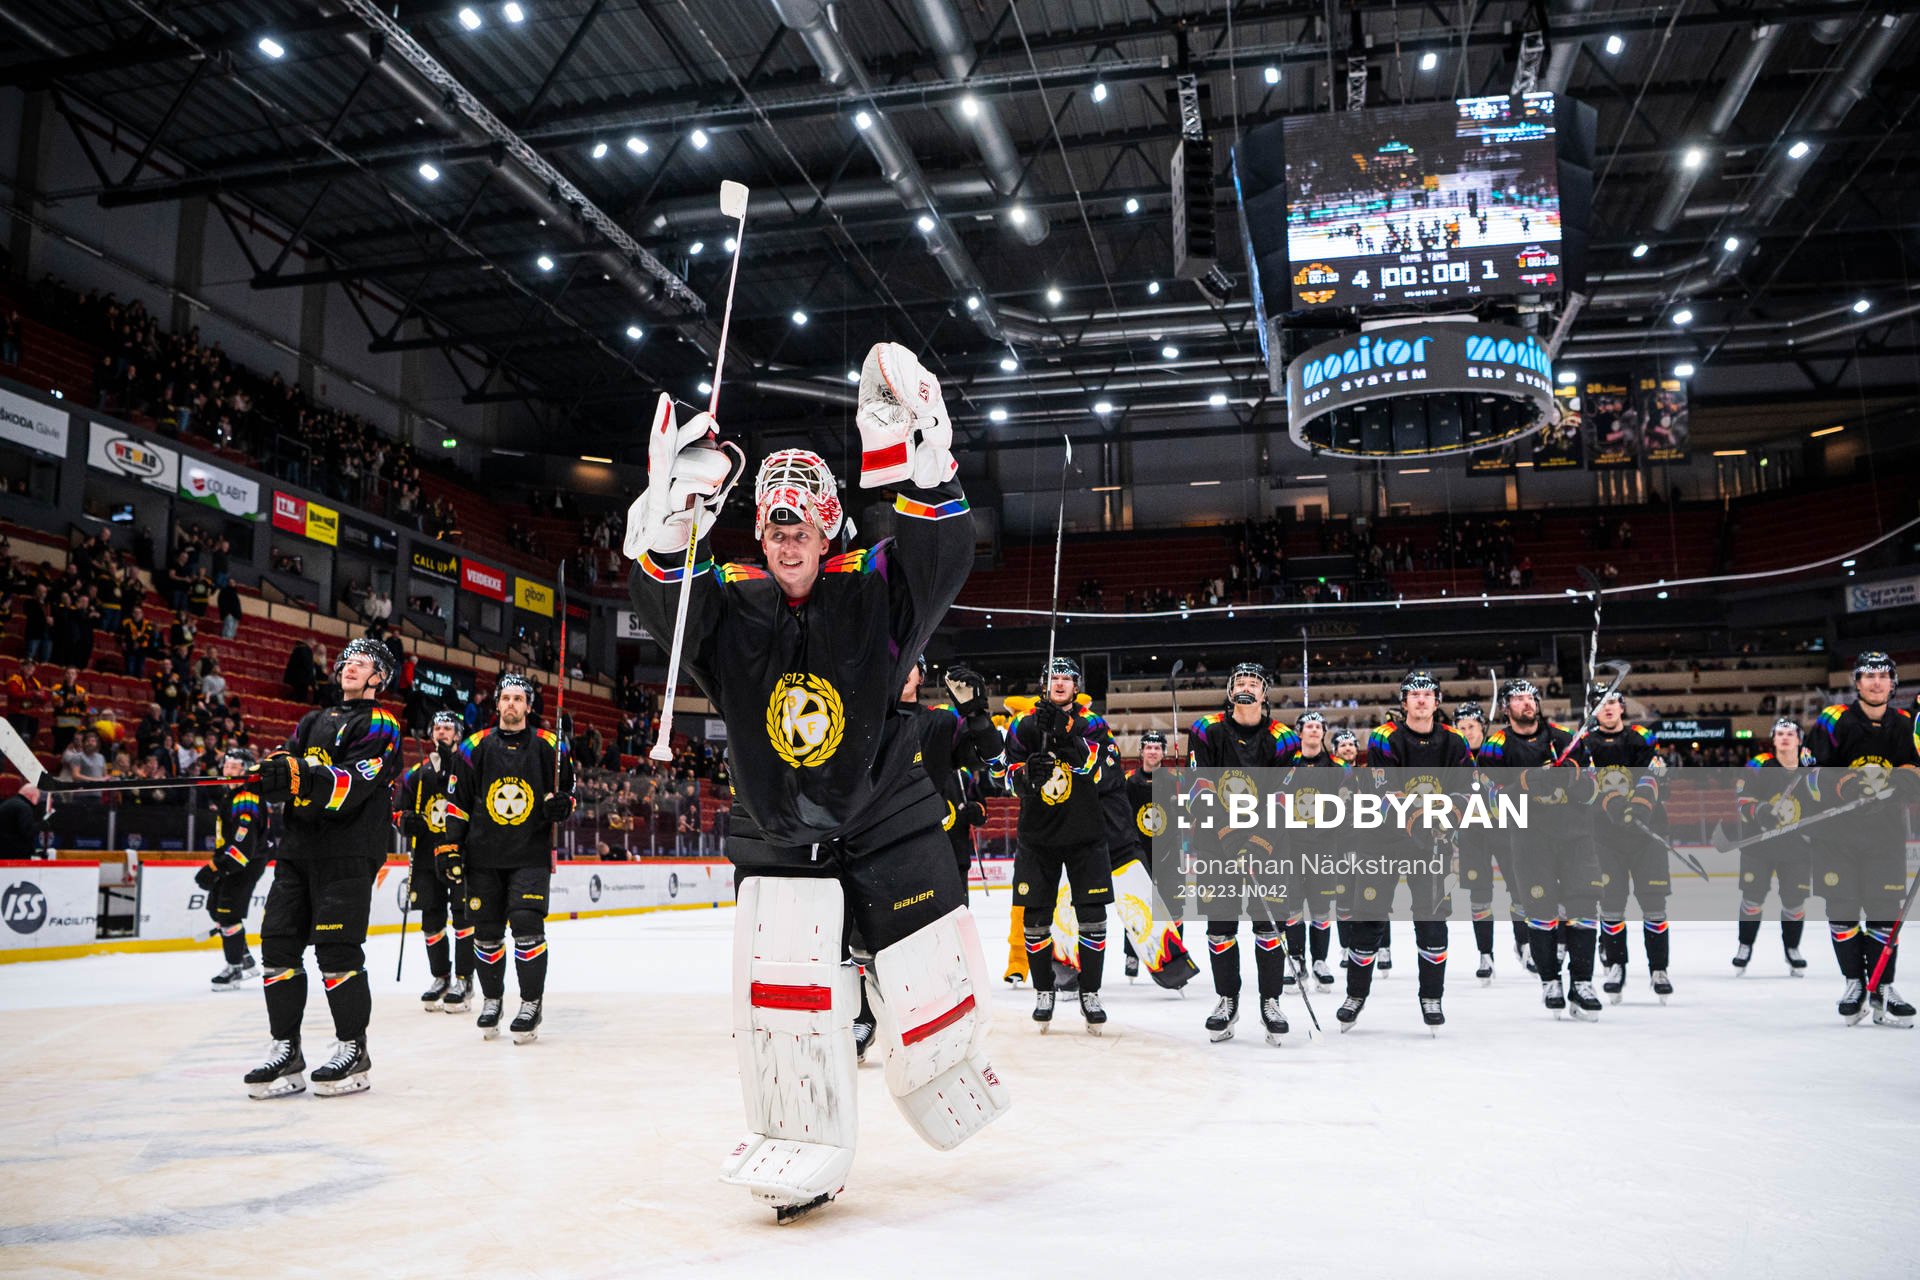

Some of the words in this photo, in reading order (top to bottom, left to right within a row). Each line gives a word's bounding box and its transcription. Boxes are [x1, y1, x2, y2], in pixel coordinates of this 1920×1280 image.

[1352, 269, 1371, 289] 4
[1385, 261, 1466, 288] 00:00
[1482, 259, 1499, 280] 1
[1303, 335, 1434, 390] monitor
[1467, 367, 1506, 379] ERP
[1304, 387, 1331, 406] ERP
[1340, 368, 1427, 392] SYSTEM
[413, 553, 435, 570] CALL
[782, 672, 805, 685] 912
[807, 721, 817, 736] F
[502, 776, 519, 784] 1912
[1418, 775, 1434, 783] 1912
[4, 893, 45, 921] ISS
